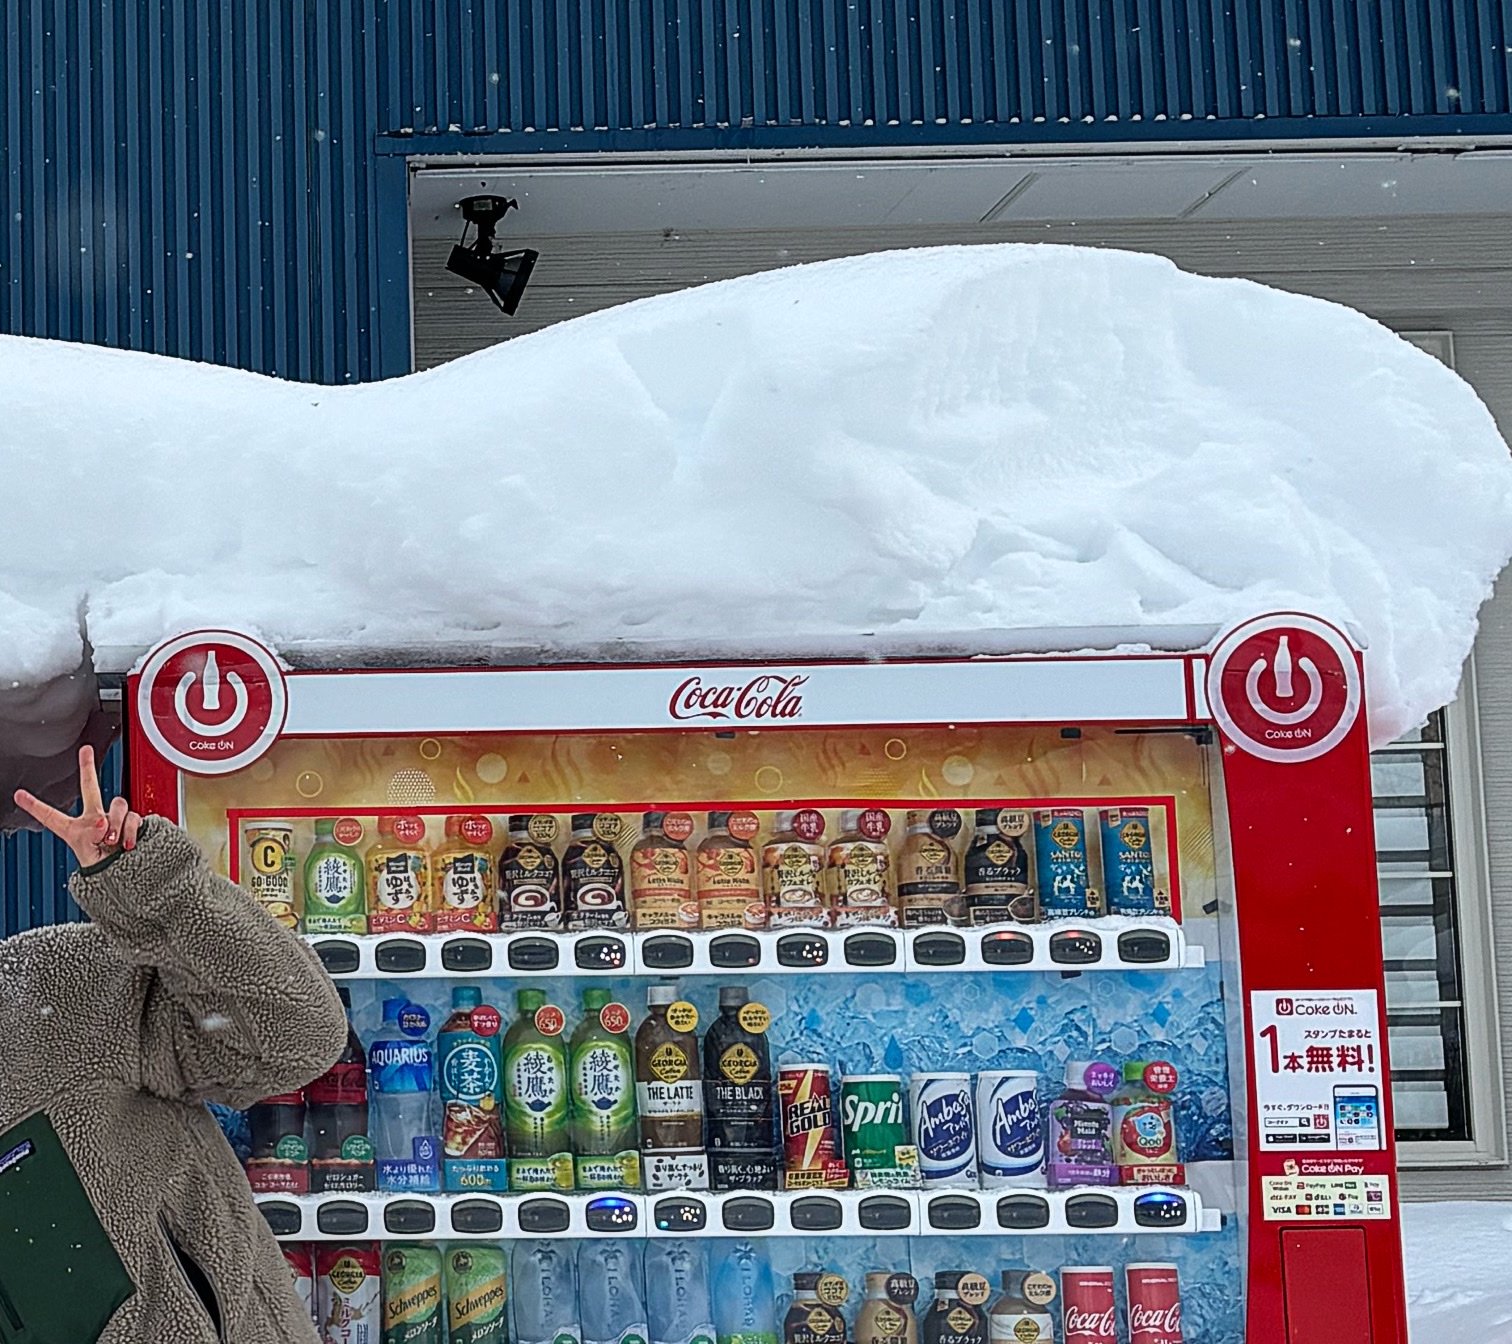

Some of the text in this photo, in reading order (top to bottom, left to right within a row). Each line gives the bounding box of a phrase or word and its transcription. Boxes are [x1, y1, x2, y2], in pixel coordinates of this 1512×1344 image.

[669, 675, 810, 719] Coca-Cola
[189, 740, 216, 750] Coke
[1295, 1005, 1330, 1015] Coke
[1304, 1029, 1372, 1039] スタンプたまると
[371, 1047, 430, 1065] AQUARIUS
[460, 1050, 483, 1094] 麦茶
[523, 1051, 547, 1097] 綾鷹
[589, 1050, 613, 1095] 綾鷹
[648, 1087, 693, 1100] THE LATTE
[716, 1087, 732, 1100] THE
[789, 1110, 831, 1136] GOLD
[383, 1165, 433, 1174] 水より優れた
[1301, 1165, 1327, 1173] Coke
[1345, 1165, 1364, 1174] Pay
[387, 1175, 430, 1185] 水分補給
[388, 1284, 438, 1320] Schweppes
[455, 1285, 504, 1320] Schweppes
[939, 1335, 983, 1344] 香るブラック
